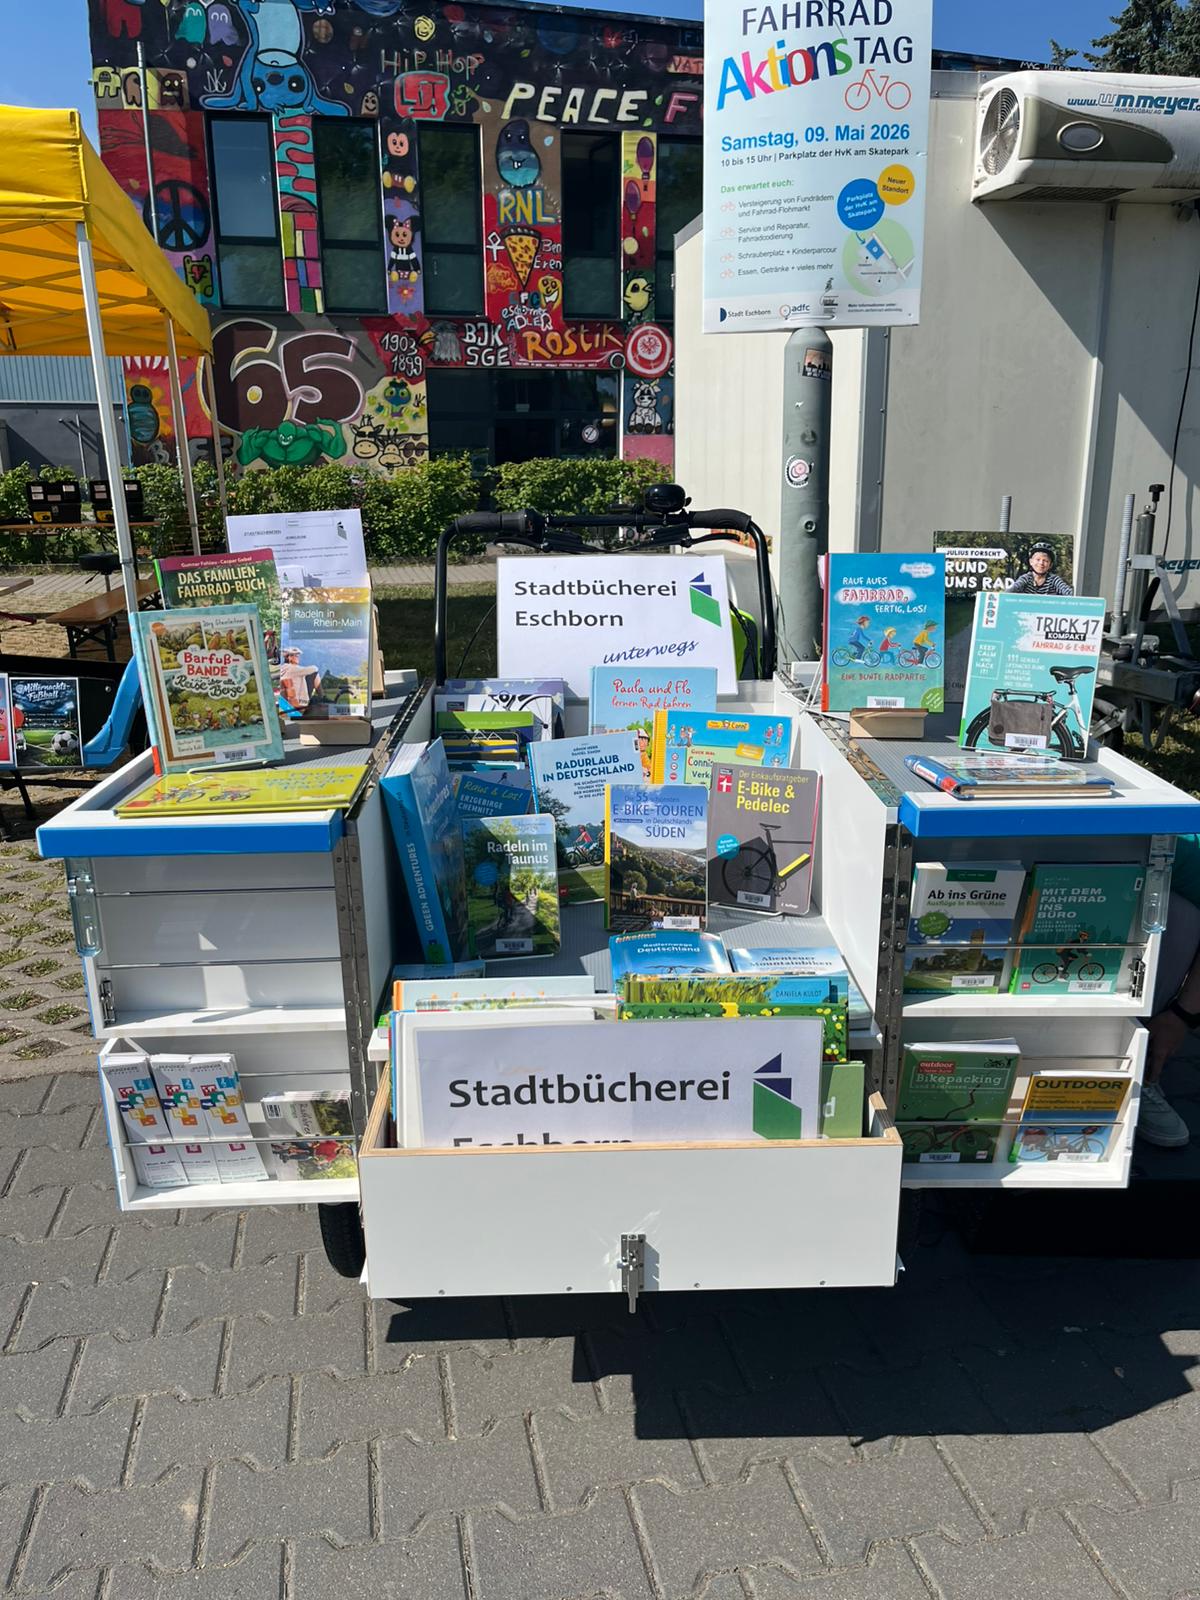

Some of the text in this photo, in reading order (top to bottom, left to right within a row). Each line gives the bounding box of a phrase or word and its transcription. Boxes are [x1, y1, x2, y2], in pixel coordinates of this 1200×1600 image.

[742, 0, 893, 36] FAHRRAD
[721, 124, 910, 152] Samstag, 09. Mai 2026
[721, 159, 730, 167] 10
[732, 157, 744, 166] bis
[746, 156, 756, 164] 15
[757, 154, 772, 163] Uhr
[778, 150, 817, 161] Parkplatz
[819, 149, 833, 158] der
[835, 148, 852, 157] HvK
[869, 147, 910, 157] Skatepark
[720, 179, 795, 194] Das erwartet euch:
[887, 177, 906, 185] Neuer
[882, 185, 909, 194] Standort
[499, 189, 555, 224] RNL
[738, 197, 783, 209] Versteigerung
[783, 196, 796, 204] von
[738, 210, 751, 218] und
[738, 226, 761, 234] Service
[763, 223, 775, 231] und
[760, 265, 789, 274] Getränke
[727, 310, 744, 318] Stadt
[791, 303, 811, 312] adfc
[463, 322, 503, 347] BJK
[466, 347, 511, 366] SGE
[198, 317, 364, 434] 65
[945, 561, 988, 574] RUND
[178, 565, 261, 585] DAS FAMILIEN-
[866, 576, 888, 584] AUFS
[177, 577, 266, 598] FAHRRAD-BUCH
[515, 580, 677, 597] Stadtbücherei
[945, 577, 1015, 590] UMS RAD
[294, 609, 335, 619] Radeln in
[515, 609, 624, 627] Eschborn
[313, 618, 362, 628] Rhein-Main
[1036, 616, 1101, 636] TRICK 17
[1048, 632, 1086, 640] KOMPAKT
[603, 639, 699, 664] unterwegs
[1032, 641, 1063, 650] FAHRRAD
[1074, 644, 1096, 652] E-BIKE
[183, 652, 240, 665] Barfuß-
[187, 664, 228, 676] BANDE
[613, 679, 692, 695] Paula und Flo
[612, 696, 691, 709] lernen Rad fahren
[555, 755, 620, 770] RADURLAUB
[543, 763, 635, 782] IN DEUTSCHLAND
[739, 770, 749, 779] Der
[738, 780, 795, 799] E-Bike &
[458, 803, 494, 816] CHEMNITZ
[613, 804, 703, 817] E-BIKE-TOUREN
[736, 796, 790, 814] Pedelec
[646, 825, 686, 838] SÜDEN
[487, 840, 547, 853] Radeln im
[505, 853, 549, 865] Taunus
[407, 843, 426, 900] ADVENTURES
[927, 889, 1007, 900] Ab ins Grüne
[1040, 895, 1107, 903] FAHRRAD
[1039, 903, 1063, 911] INS
[420, 902, 434, 932] GREEN
[1037, 911, 1077, 919] BÜRO
[917, 1073, 1002, 1086] Bikepacking
[1035, 1080, 1124, 1090] OUTDOOR
[448, 1070, 731, 1108] Stadtbücherei
